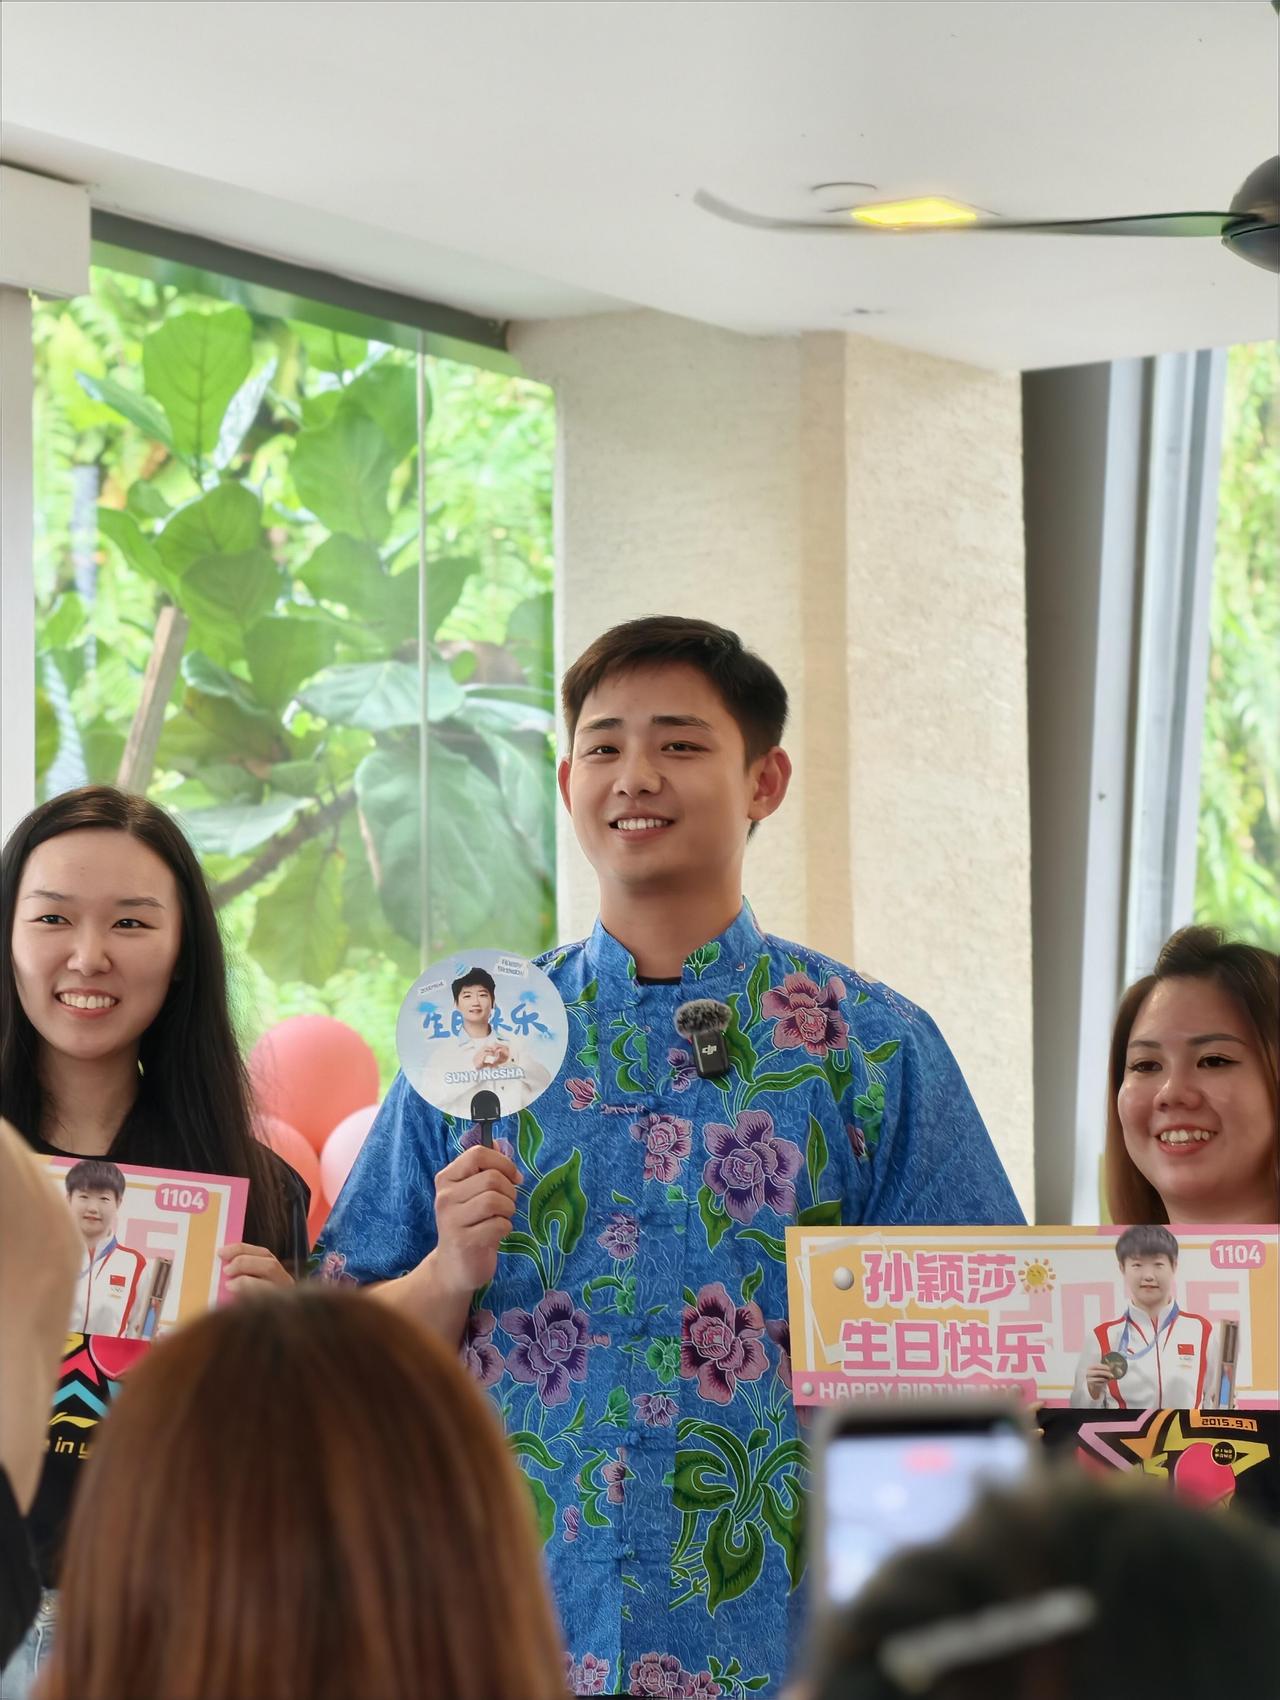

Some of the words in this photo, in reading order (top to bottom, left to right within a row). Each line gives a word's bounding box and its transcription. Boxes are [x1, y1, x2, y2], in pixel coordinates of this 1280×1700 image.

[161, 1187, 205, 1210] 1104
[1215, 1244, 1261, 1264] 1104
[864, 1252, 1017, 1304] 孙颖莎
[842, 1320, 1048, 1374] 生日快乐
[819, 1382, 893, 1400] HAPPY
[1201, 1418, 1254, 1430] 2015.9.1
[54, 1436, 75, 1454] in
